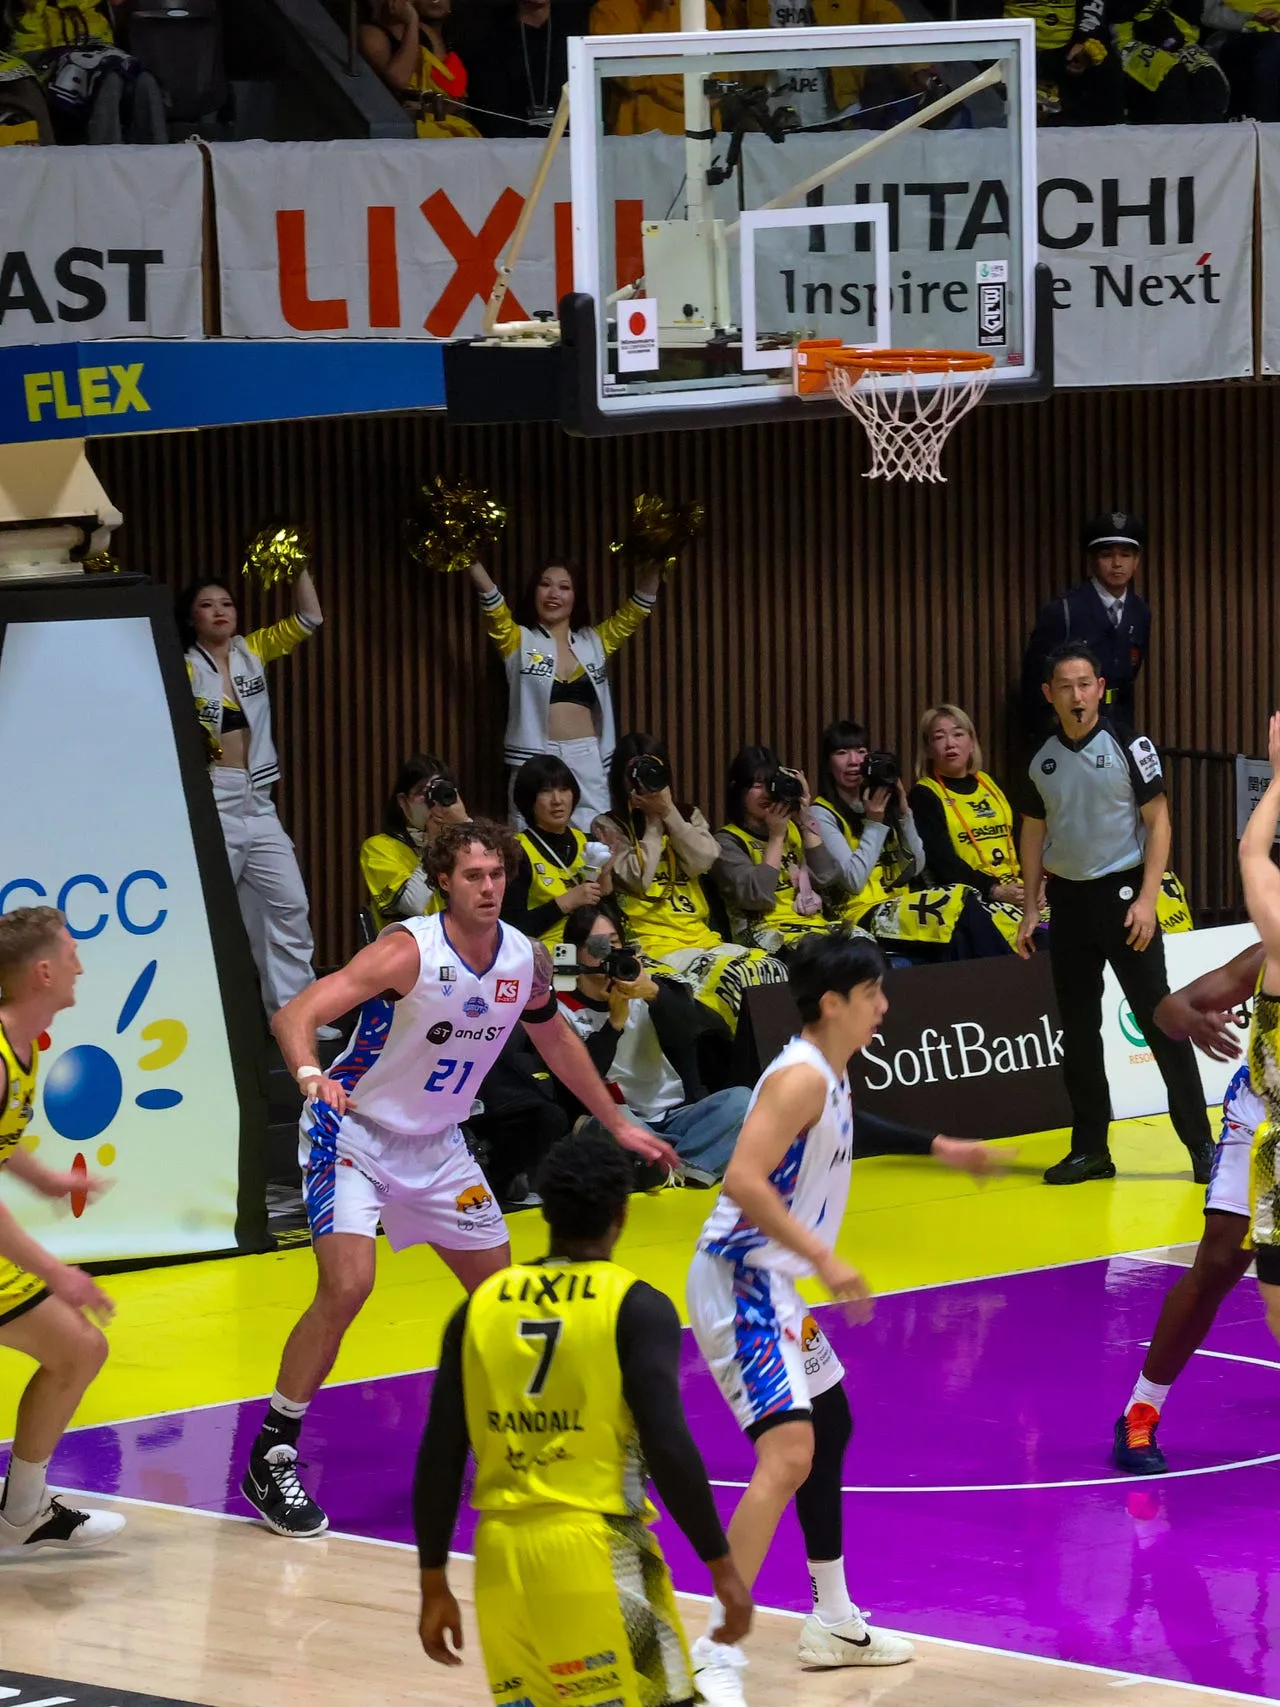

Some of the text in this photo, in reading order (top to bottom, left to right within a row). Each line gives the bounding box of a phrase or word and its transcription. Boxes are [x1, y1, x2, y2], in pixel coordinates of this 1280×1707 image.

[805, 176, 1195, 252] HITACHI
[1093, 252, 1221, 308] Next
[24, 362, 151, 422] FLEX
[455, 1029, 483, 1041] and
[485, 1026, 506, 1042] ST
[861, 1014, 1065, 1091] SoftBank
[424, 1059, 475, 1095] 21
[497, 1271, 597, 1306] LIXIL
[518, 1318, 564, 1397] 7
[487, 1409, 586, 1433] RANDALL
